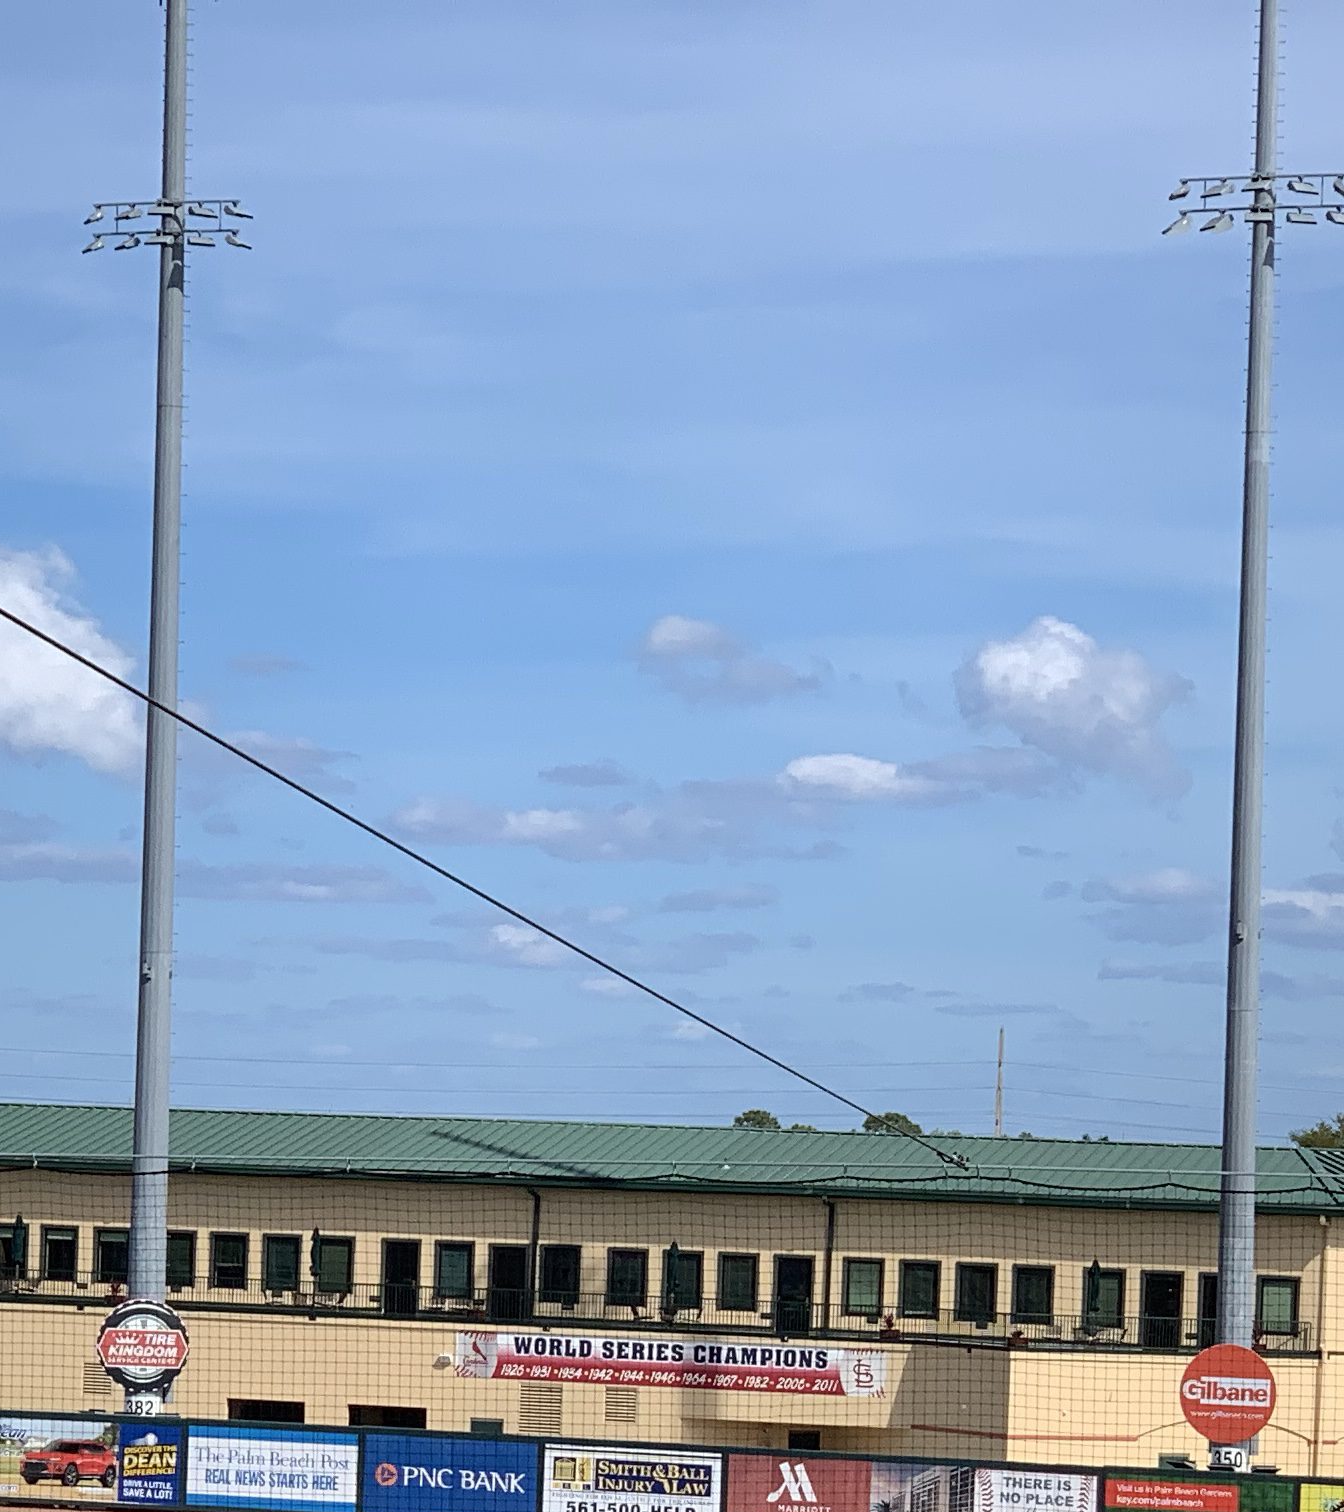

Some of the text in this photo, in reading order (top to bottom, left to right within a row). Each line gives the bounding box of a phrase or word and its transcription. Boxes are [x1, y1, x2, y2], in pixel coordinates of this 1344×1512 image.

[144, 1333, 176, 1345] TIRE
[108, 1345, 178, 1358] KINGDOM
[514, 1336, 828, 1369] WORLD SERIES CHAMPIONS
[1182, 1378, 1268, 1403] Gilbane
[127, 1400, 154, 1416] 382
[124, 1452, 177, 1469] DEAN
[195, 1446, 350, 1471] The Palm Beach Post
[1214, 1450, 1243, 1468] 350
[205, 1468, 339, 1491] REAL NEWS STARTS HERE
[402, 1465, 525, 1494] PNC BANK
[597, 1476, 655, 1493] INJURY
[671, 1480, 709, 1496] LAW
[1003, 1476, 1072, 1492] THERE IS
[123, 1488, 173, 1500] SAVE A LOT!
[999, 1491, 1074, 1507] NO PLACE
[1116, 1483, 1233, 1498] Visit us in Palm Beach Gardens
